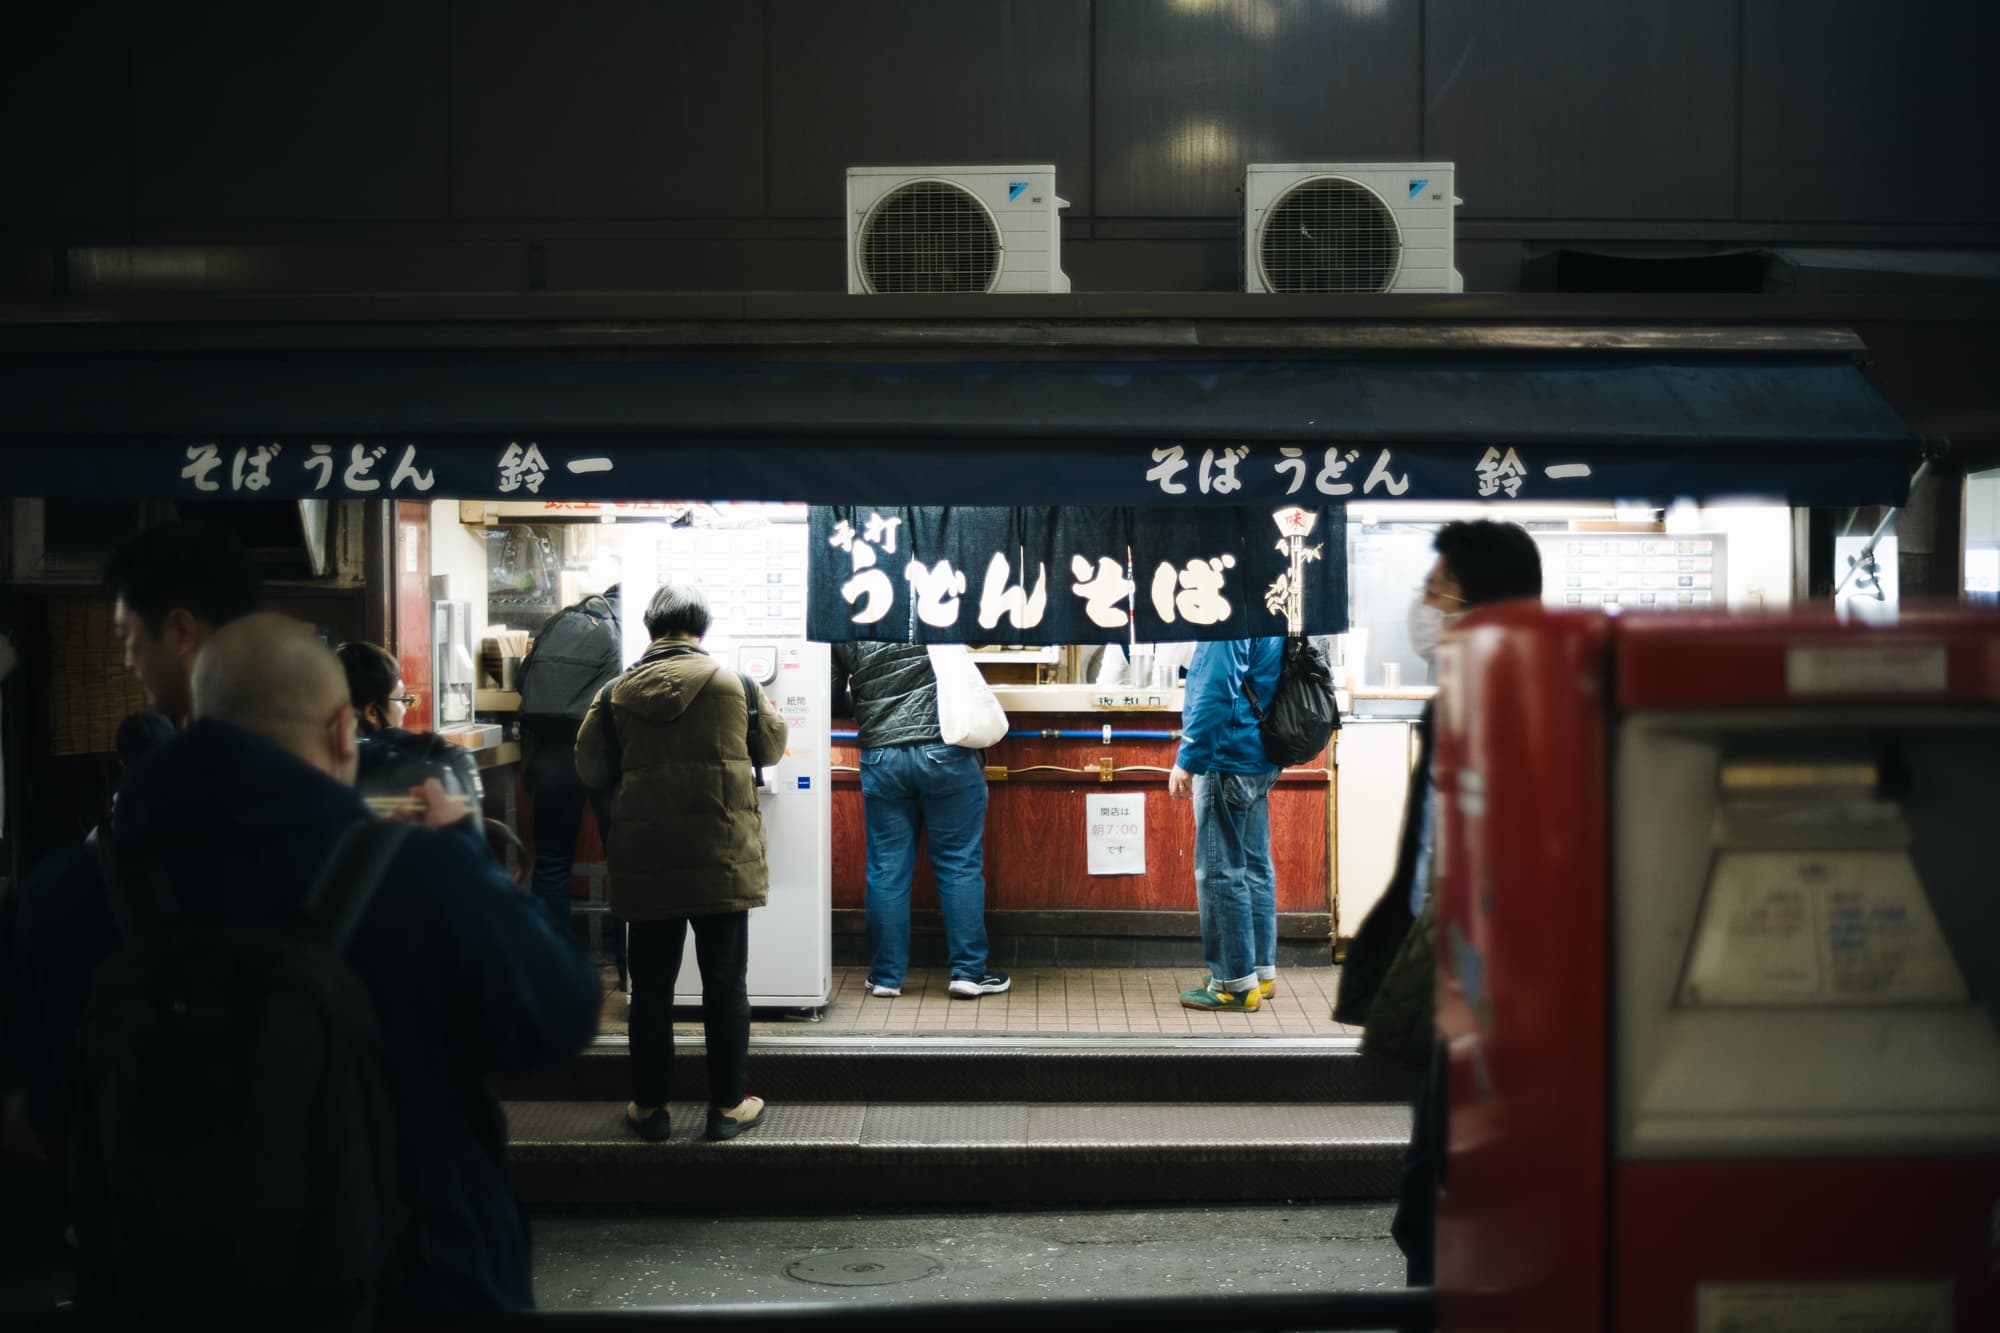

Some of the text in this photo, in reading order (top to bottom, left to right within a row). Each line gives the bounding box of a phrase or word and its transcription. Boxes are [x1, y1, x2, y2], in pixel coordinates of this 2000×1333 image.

[181, 442, 613, 493] そば うどん 鈴一
[1145, 444, 1592, 498] そば うどん 鈴一
[1284, 511, 1305, 530] 味
[1100, 807, 1131, 817] 開店は
[1106, 845, 1125, 855] です
